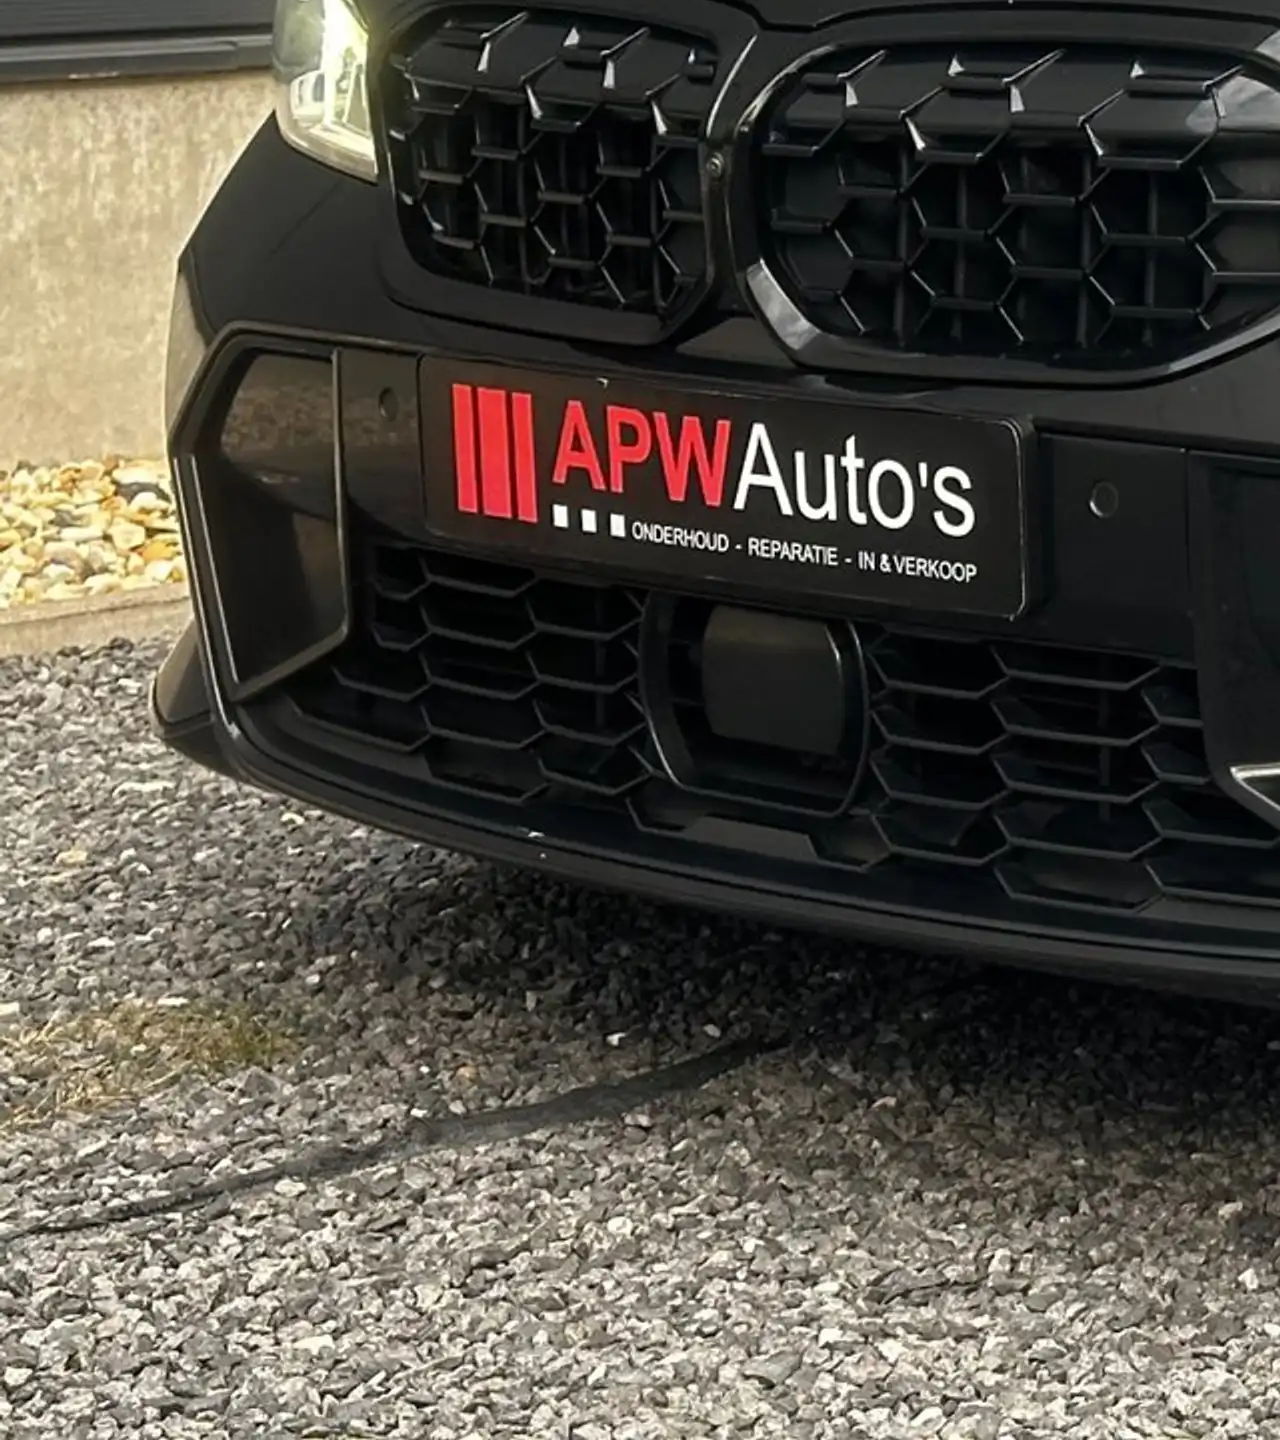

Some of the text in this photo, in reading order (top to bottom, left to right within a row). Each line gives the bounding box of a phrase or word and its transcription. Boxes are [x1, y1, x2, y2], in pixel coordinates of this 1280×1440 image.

[631, 520, 730, 553] ONDERHOUD
[748, 536, 840, 567] REPARATIE
[858, 550, 876, 572] IN
